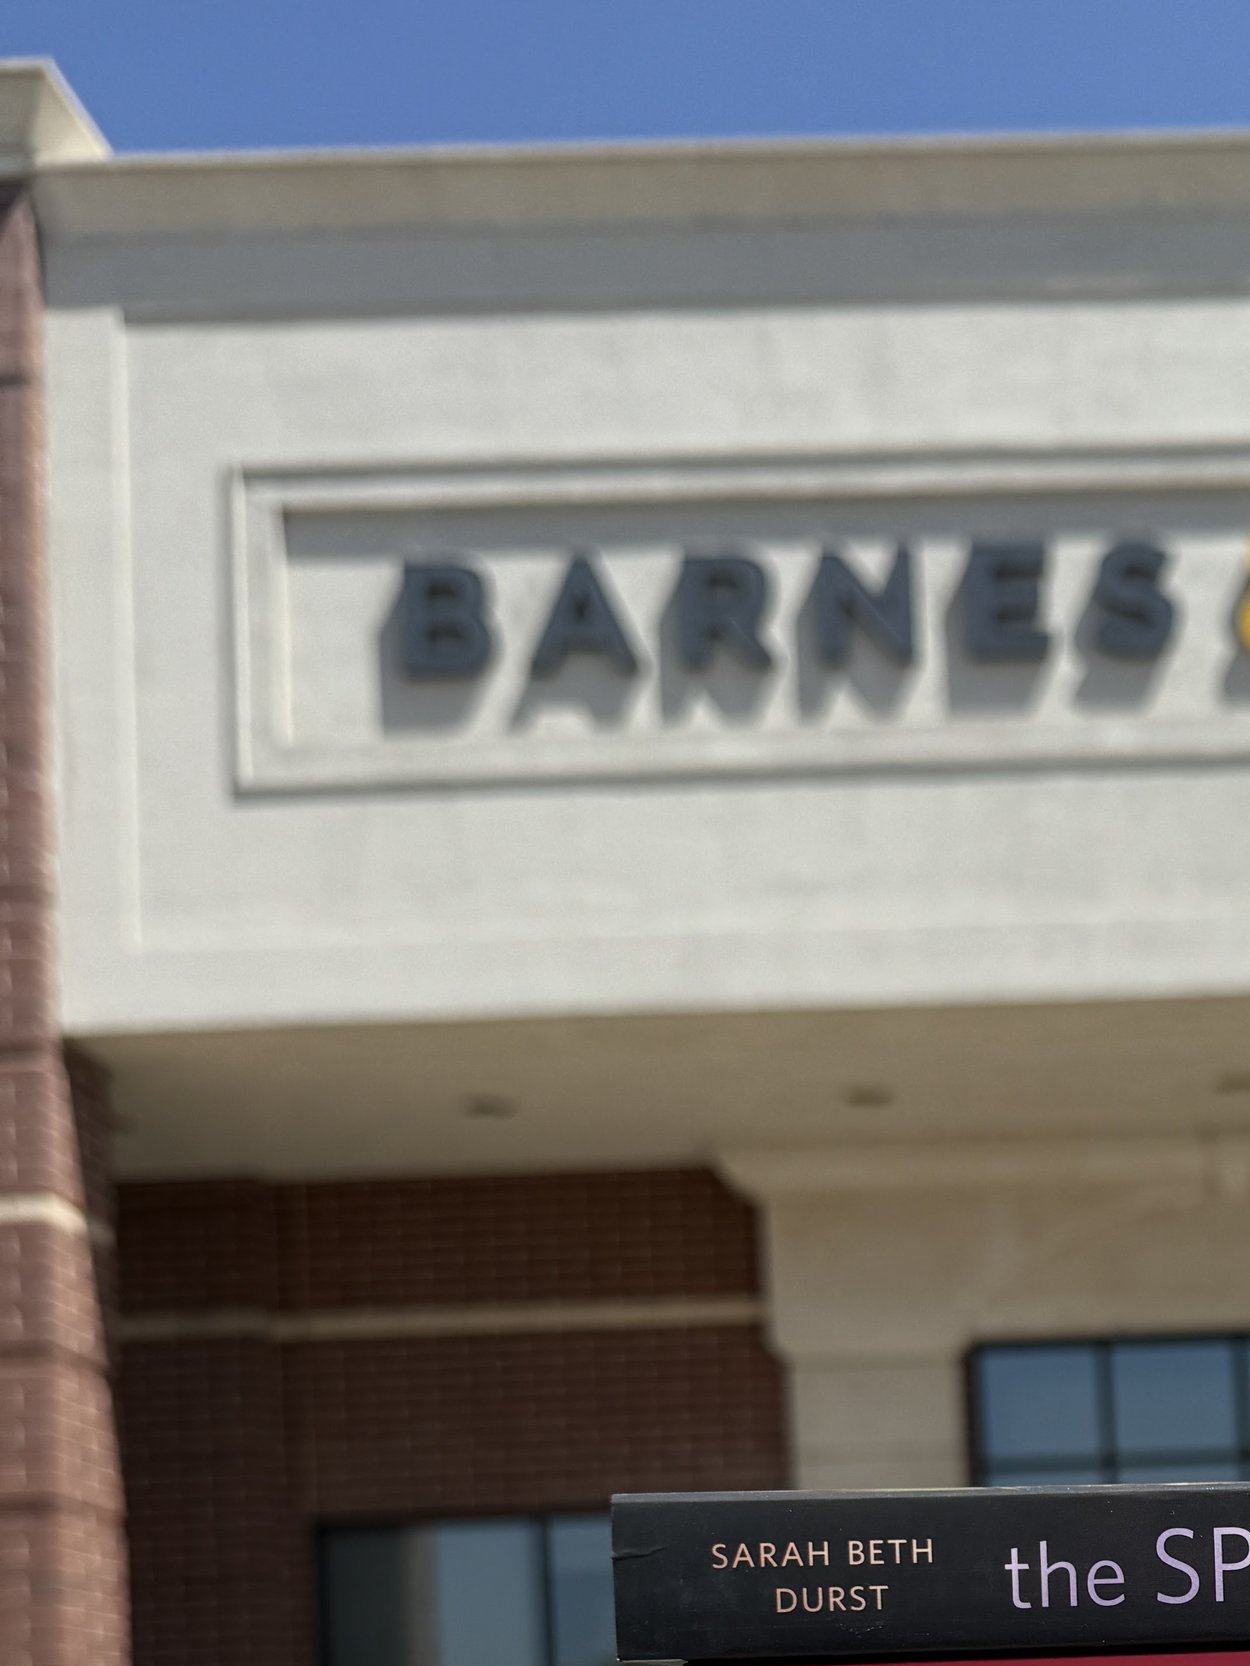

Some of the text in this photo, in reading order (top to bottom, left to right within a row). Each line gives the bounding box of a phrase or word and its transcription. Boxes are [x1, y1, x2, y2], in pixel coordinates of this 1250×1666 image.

[398, 534, 1178, 682] BARNES
[711, 1537, 934, 1570] SARAH BETH
[1004, 1540, 1126, 1609] the
[774, 1585, 889, 1615] DURST
